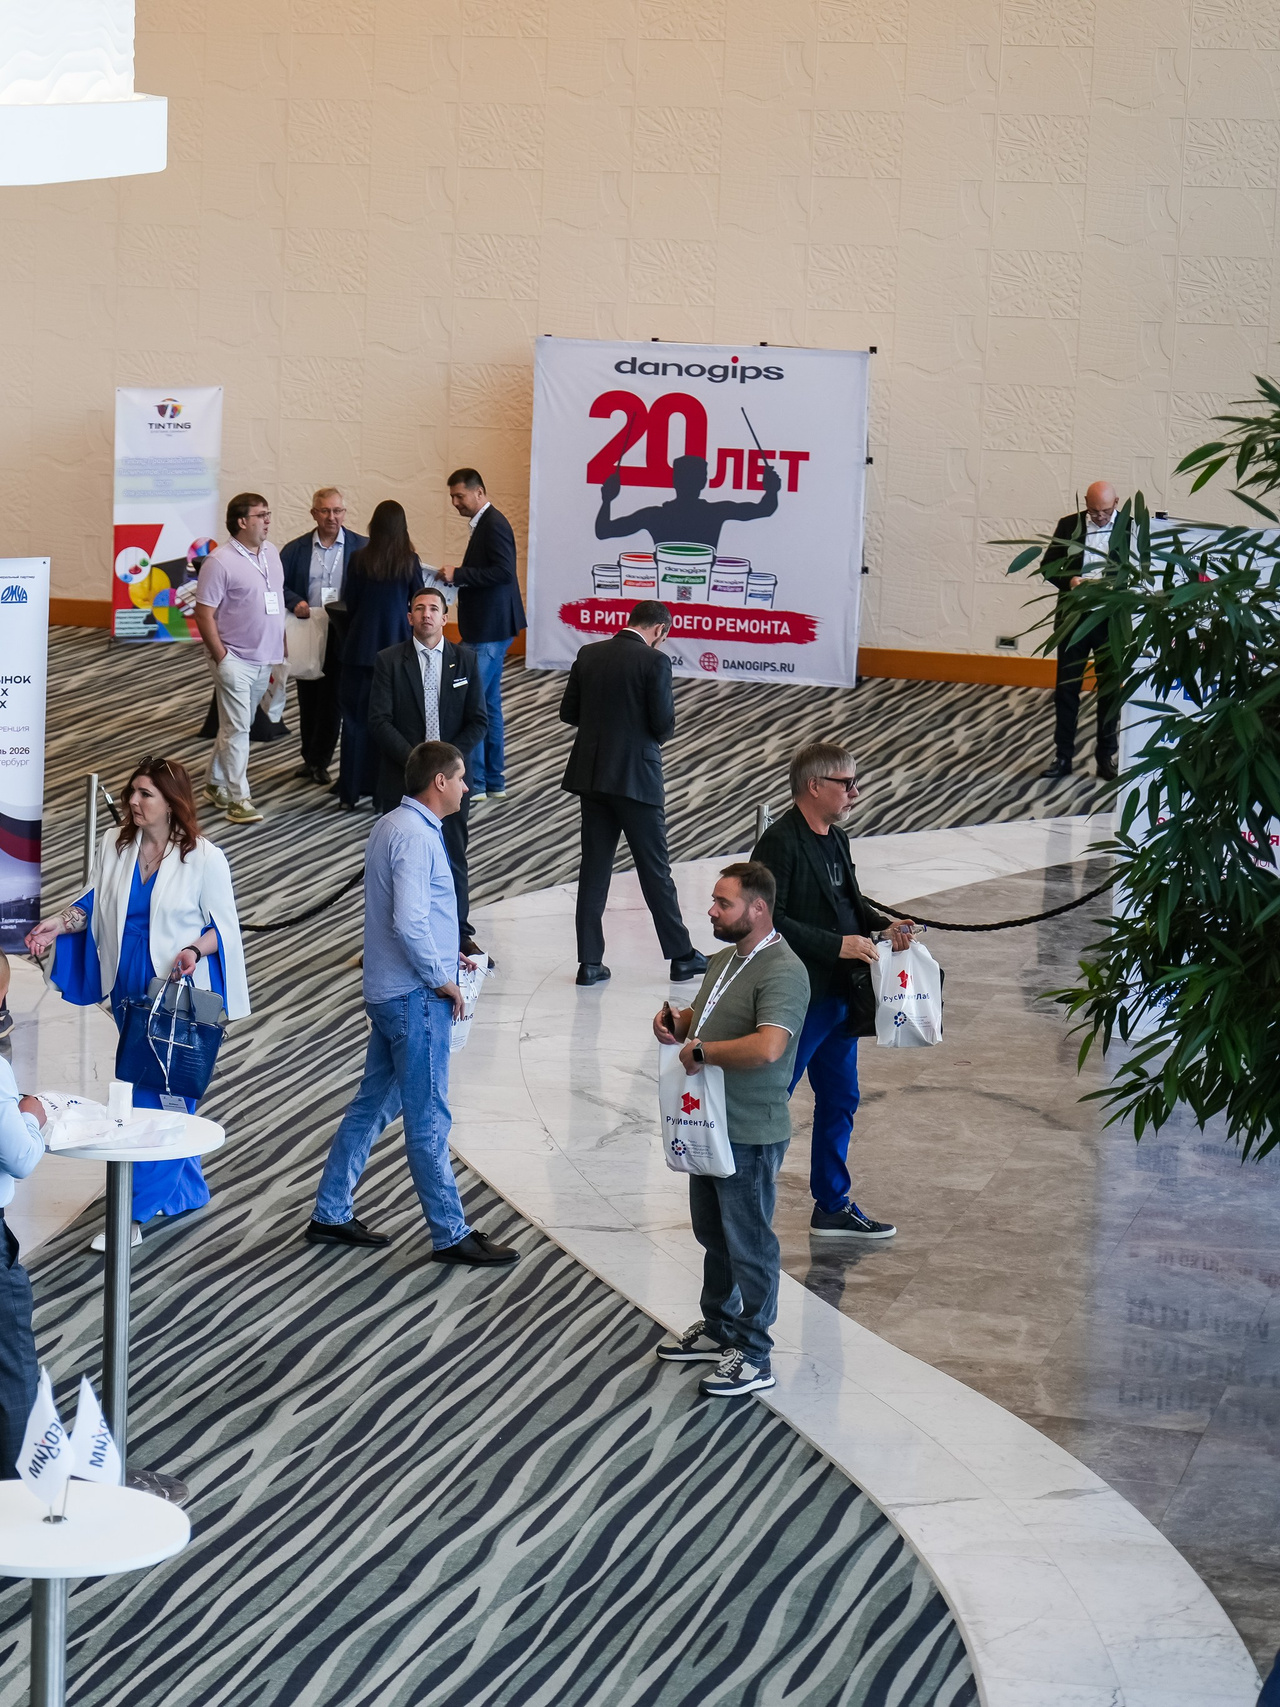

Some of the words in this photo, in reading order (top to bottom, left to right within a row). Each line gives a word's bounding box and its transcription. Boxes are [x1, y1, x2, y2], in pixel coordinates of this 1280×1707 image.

[614, 356, 785, 384] danogips
[148, 422, 192, 430] TINTING
[586, 390, 708, 489] 20
[709, 448, 810, 492] ЛЕТ
[664, 566, 707, 574] danogips
[1, 585, 28, 603] OMYA
[580, 610, 591, 624] В
[670, 615, 712, 630] ОЕГО
[716, 618, 791, 636] РЕМОНТА
[722, 659, 795, 673] DANOGIPS.RU
[9, 747, 30, 755] 2026
